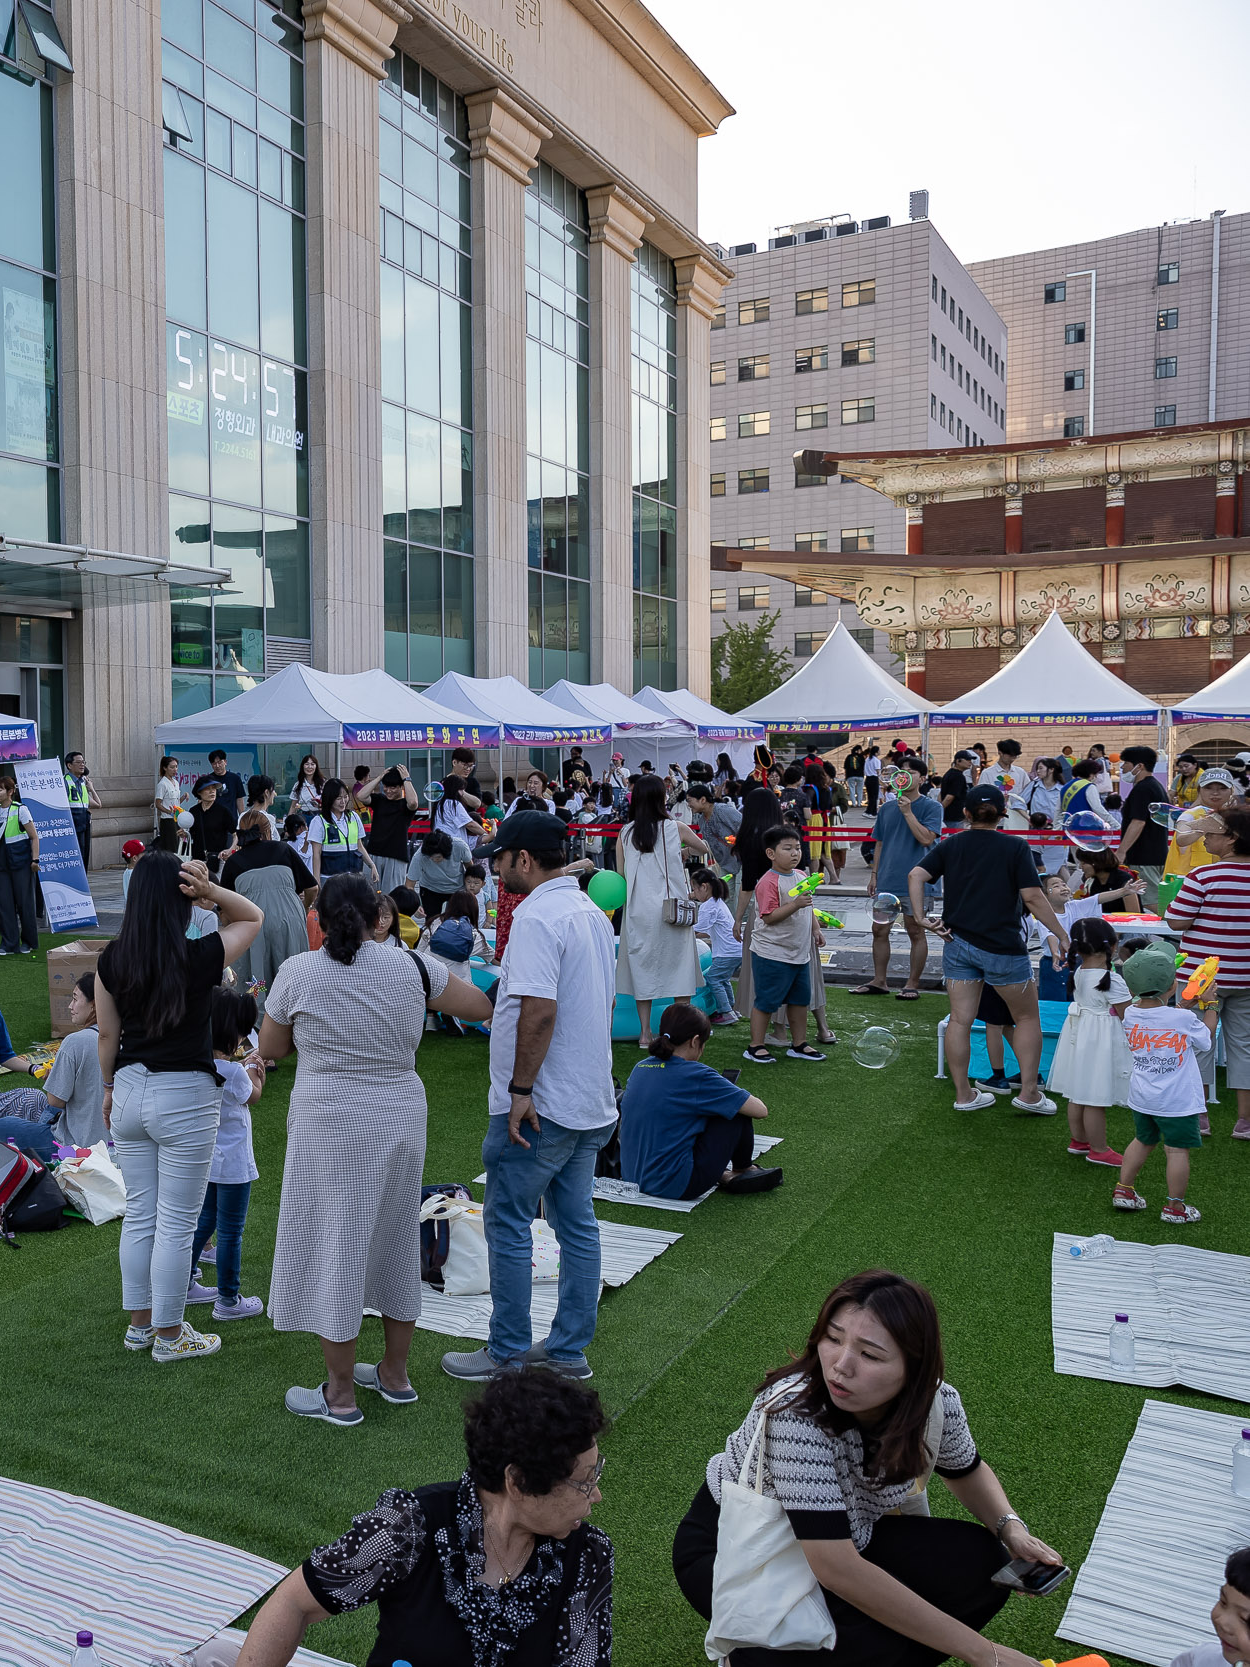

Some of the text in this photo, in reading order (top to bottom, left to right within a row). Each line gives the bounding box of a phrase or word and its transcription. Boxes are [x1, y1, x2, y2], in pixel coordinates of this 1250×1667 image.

[451, 2, 487, 51] your
[489, 27, 514, 74] life
[168, 395, 304, 451] 스포츠 정형외과 내과의원
[965, 715, 1004, 725] 스티커로
[1007, 714, 1041, 724] 에코백
[1043, 713, 1088, 724] 완성하기
[356, 726, 481, 746] 2023 군자 한마당축제 동화구연
[20, 776, 64, 791] 바른본병원
[37, 829, 54, 839] 울의대
